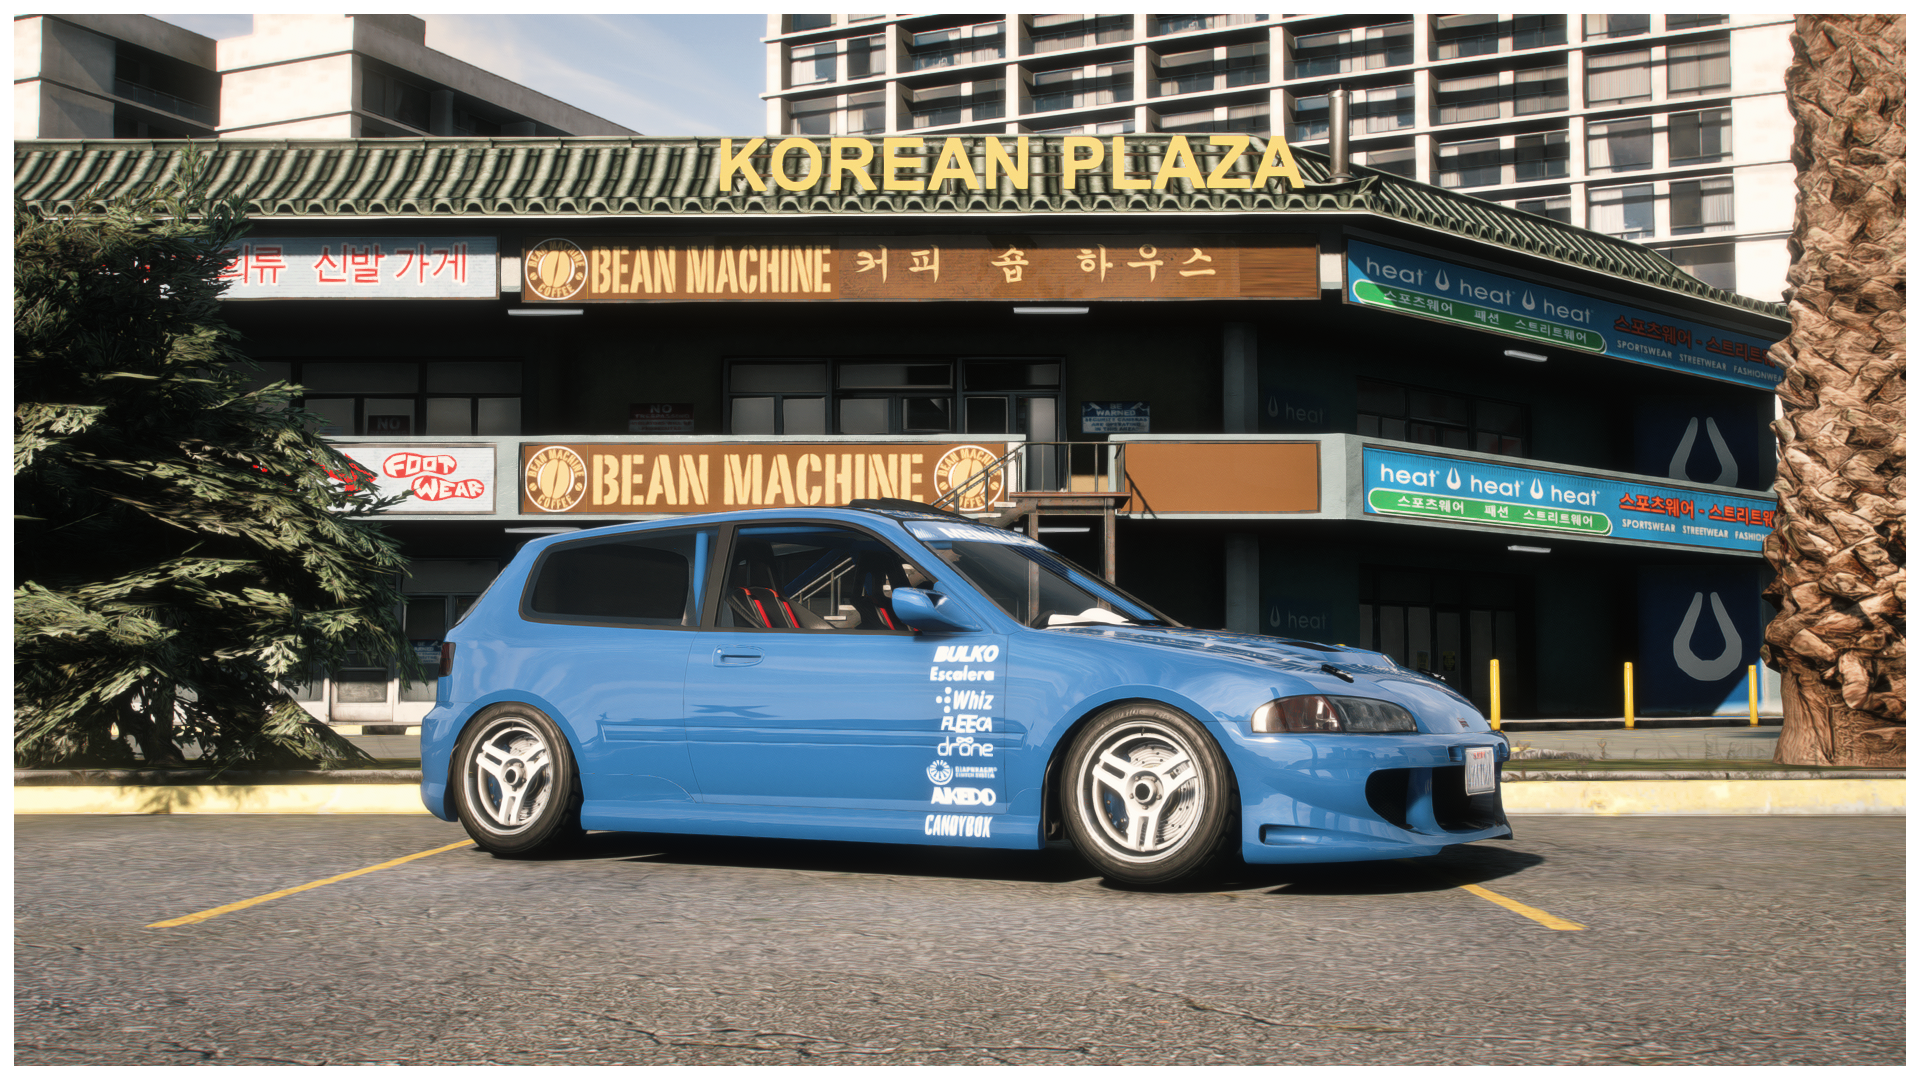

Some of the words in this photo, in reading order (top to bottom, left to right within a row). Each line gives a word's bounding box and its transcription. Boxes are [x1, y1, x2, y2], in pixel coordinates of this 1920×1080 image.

[719, 136, 1029, 191] KOREAN
[1063, 135, 1305, 189] PLAZA
[314, 243, 385, 284] 신발
[394, 243, 468, 284] 가게
[592, 245, 676, 294] BEAN
[686, 245, 831, 294] MACHINE
[855, 244, 940, 284] 커피
[1076, 244, 1216, 283] 하우스
[537, 283, 575, 298] COFFEE
[1366, 257, 1423, 285] heat
[1460, 279, 1512, 306] heat
[1543, 299, 1590, 324] heat
[1384, 290, 1453, 316] 스포츠웨어
[1474, 309, 1499, 325] 패션
[1515, 318, 1587, 344] 스트리트웨어
[1614, 315, 1692, 349] 스포츠웨어
[1616, 340, 1672, 360] SPORTSWEAR
[1679, 353, 1727, 372] STREETWEAR
[650, 404, 672, 414] NO
[1285, 402, 1324, 424] heat
[377, 417, 400, 430] NO
[384, 453, 456, 475] FOOT
[528, 453, 548, 478] BEAN
[548, 449, 585, 478] MACHINE
[938, 452, 960, 477] BEAN
[414, 478, 484, 500] WEAR
[592, 454, 708, 505] BEAN
[724, 454, 924, 505] MACHINE
[1380, 464, 1435, 487] heat
[1471, 475, 1521, 498] heat
[1551, 486, 1597, 506] heat
[537, 494, 574, 509] COFFEE
[1398, 496, 1464, 514] 스포츠웨어
[1484, 504, 1508, 518] 패션
[1523, 509, 1593, 528] 스트리트웨어
[1619, 493, 1694, 520] 스포츠웨어
[1622, 518, 1676, 532] SPORTSWEAR
[1682, 525, 1729, 538] STREETWEAR
[1288, 610, 1326, 630] heat
[933, 645, 999, 662] BULKO
[930, 665, 994, 681] Escalera
[953, 690, 994, 710] Whiz
[941, 714, 992, 733] FLEECA
[937, 736, 994, 757] drone
[924, 814, 993, 838] CANDYBOX
